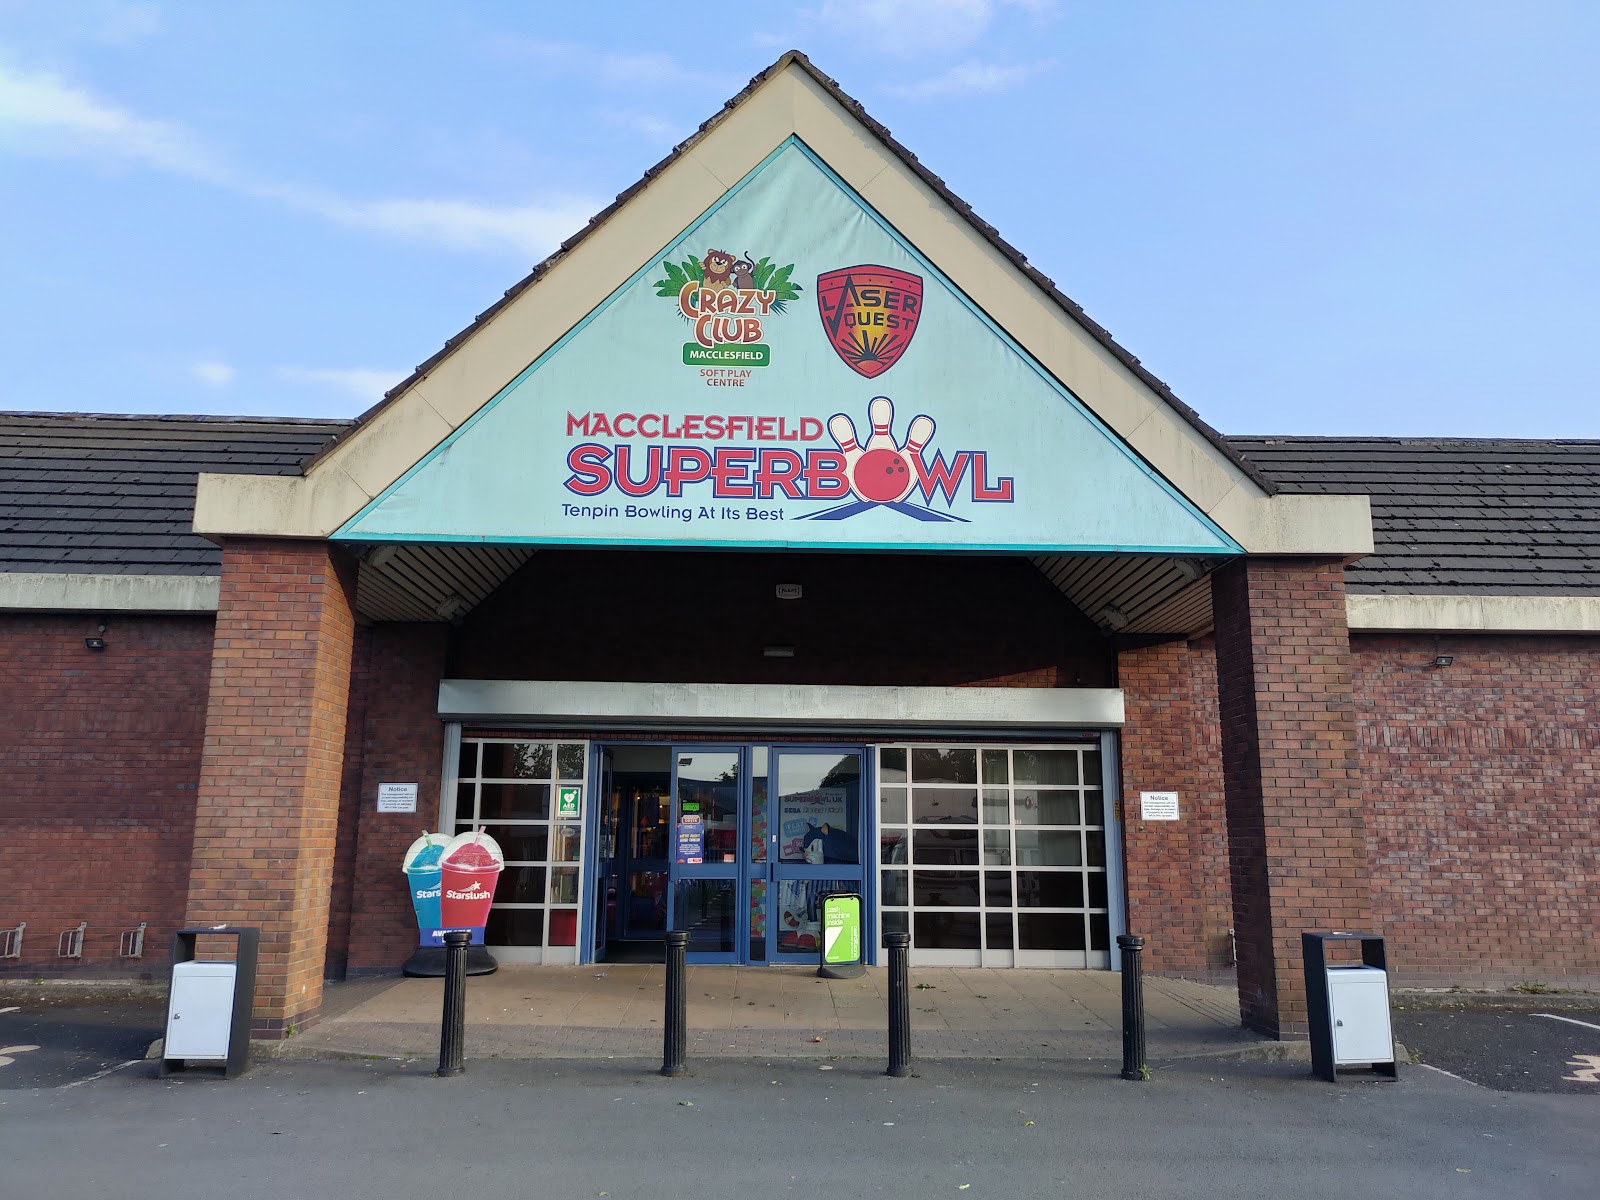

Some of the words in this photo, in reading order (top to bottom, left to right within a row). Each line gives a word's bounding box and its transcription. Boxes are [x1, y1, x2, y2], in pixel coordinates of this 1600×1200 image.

[679, 280, 776, 319] CRAZY
[822, 273, 919, 318] LASER
[844, 312, 914, 330] QUEST
[694, 314, 764, 348] CLUB
[689, 350, 763, 360] MACCLESFIELD
[700, 369, 725, 378] SOFT
[727, 369, 752, 378] PLAY
[706, 378, 745, 387] CENTRE
[566, 411, 823, 441] MACCLESFIELD
[562, 504, 619, 520] Tenpin
[625, 505, 692, 522] Bowling
[698, 506, 716, 520] At
[721, 507, 740, 520] Its
[746, 507, 784, 521] Best
[446, 889, 491, 900] Starslush
